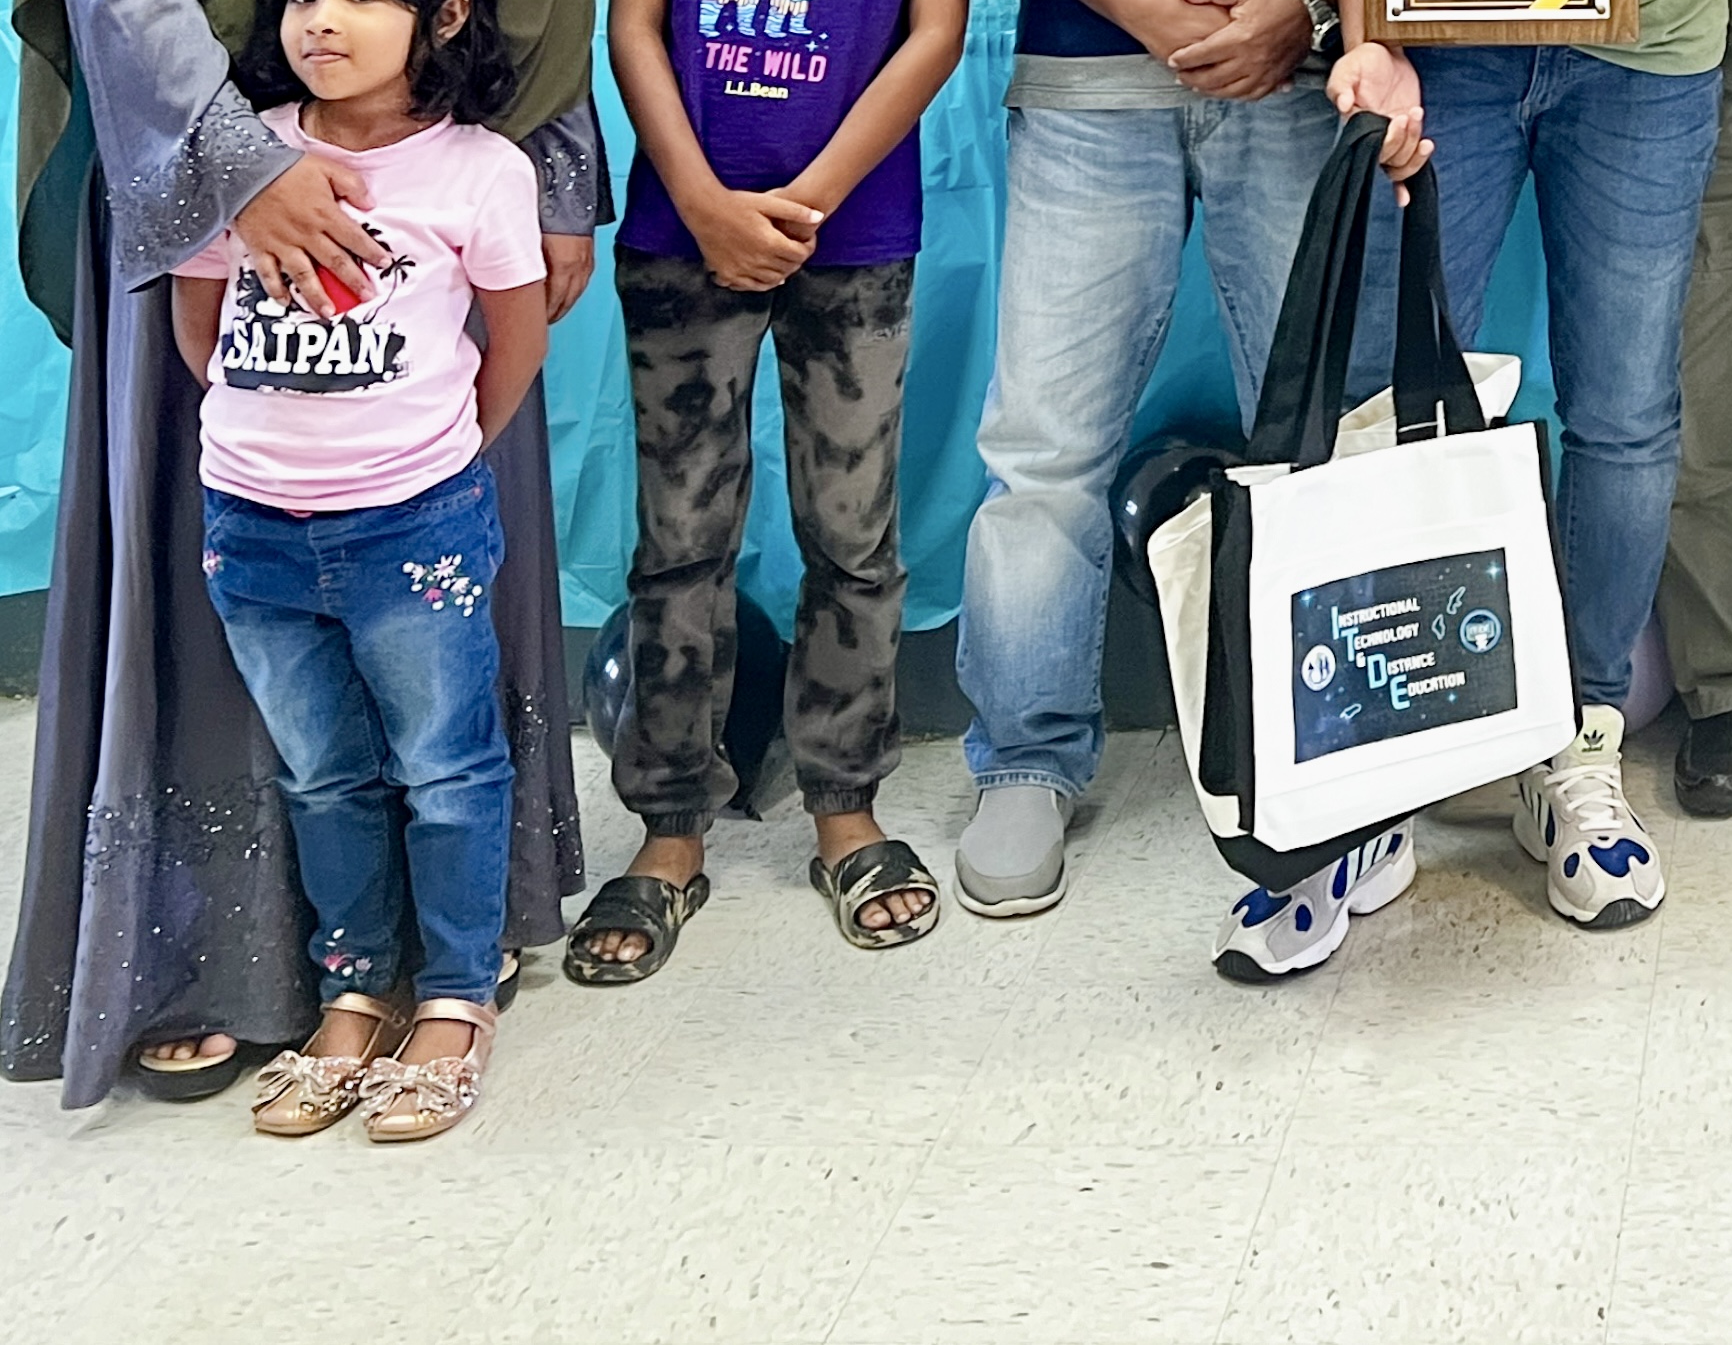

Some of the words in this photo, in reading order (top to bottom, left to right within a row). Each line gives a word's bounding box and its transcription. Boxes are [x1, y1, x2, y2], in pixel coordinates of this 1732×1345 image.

[705, 42, 753, 74] THE
[763, 50, 827, 83] WILD
[723, 80, 789, 100] L.L.Bean
